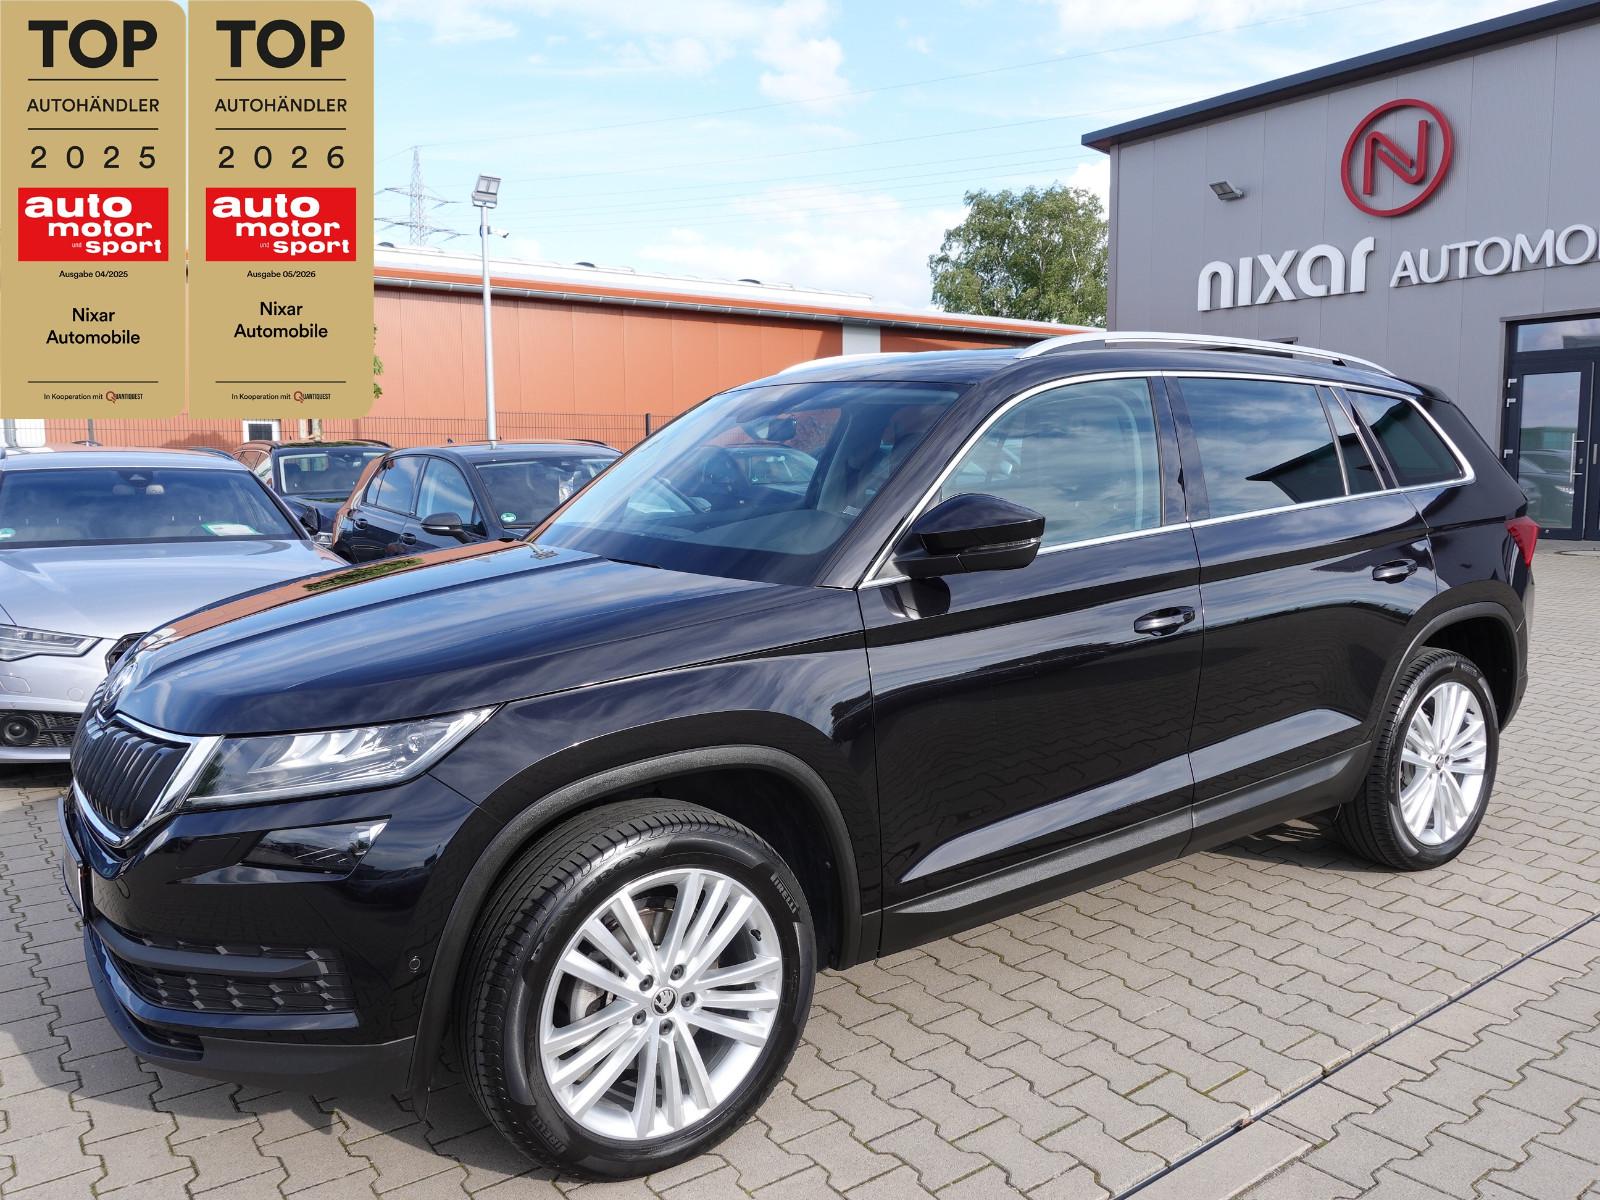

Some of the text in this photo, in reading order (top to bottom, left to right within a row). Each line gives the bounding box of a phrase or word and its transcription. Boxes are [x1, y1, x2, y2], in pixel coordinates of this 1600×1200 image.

[1198, 223, 1600, 312] nixar AUTOMO
[769, 871, 799, 914] PIRELLI
